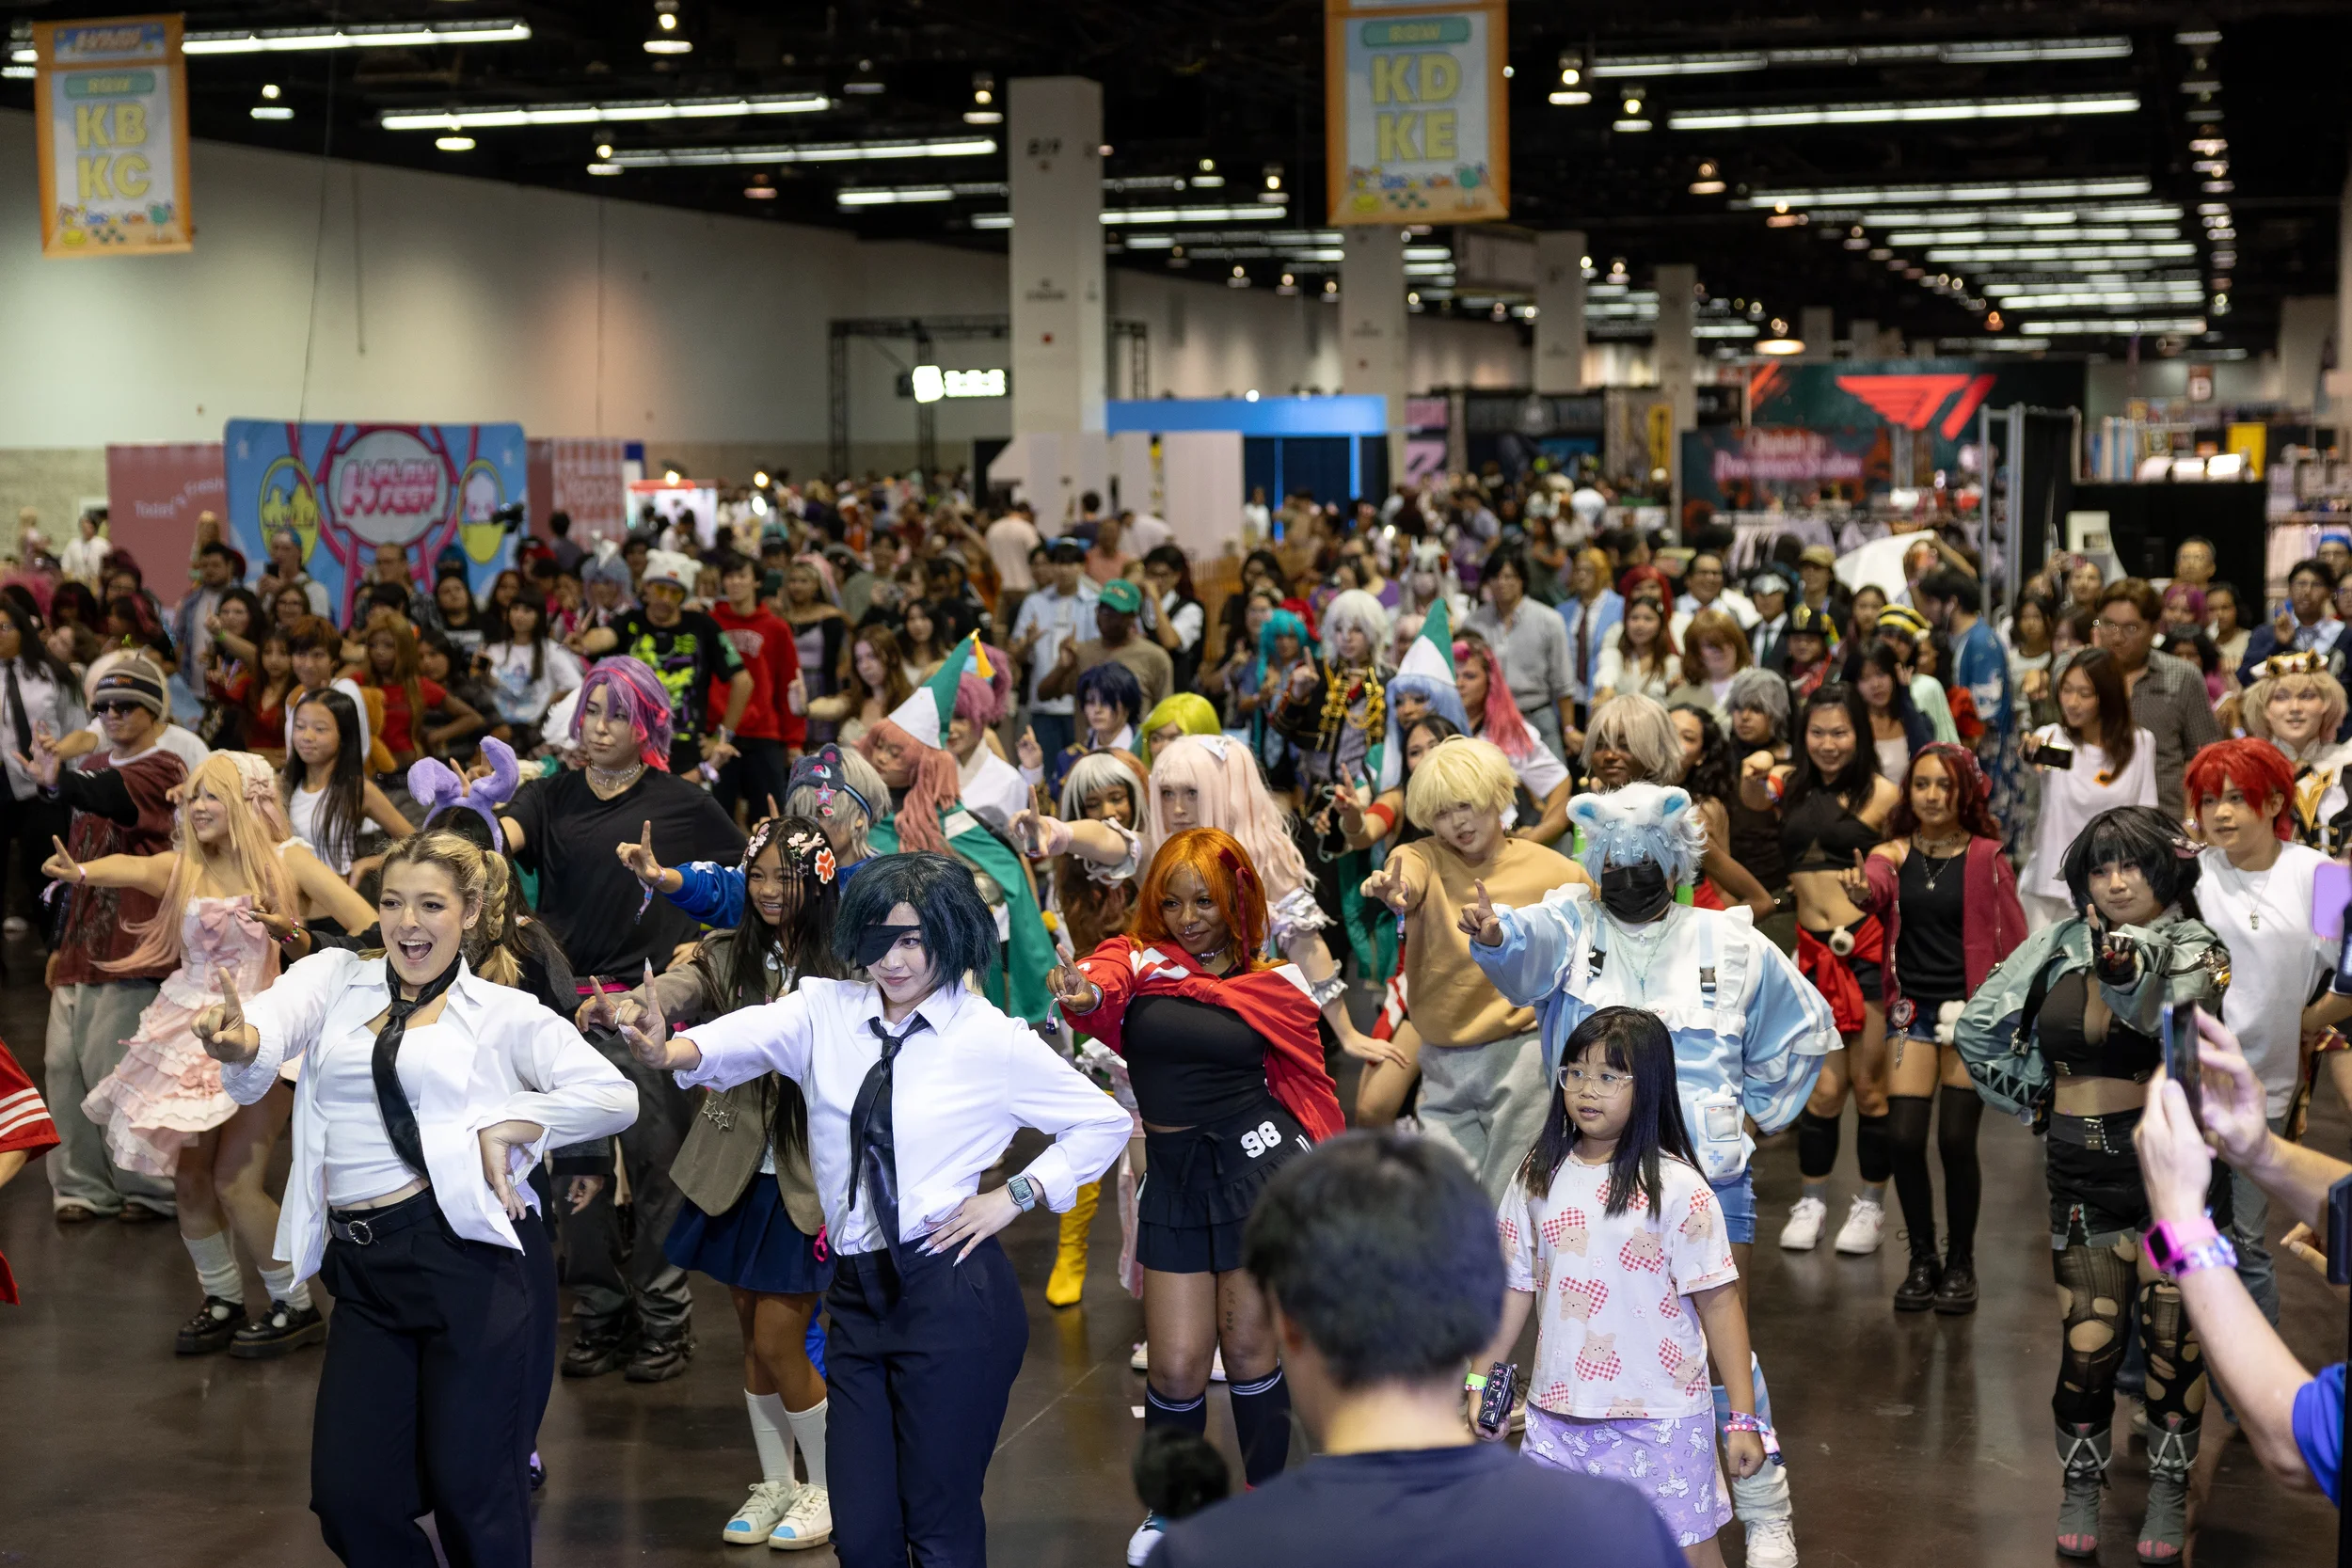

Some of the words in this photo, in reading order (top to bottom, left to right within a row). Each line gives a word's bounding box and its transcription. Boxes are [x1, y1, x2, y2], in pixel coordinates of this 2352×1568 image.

[1373, 52, 1462, 103] KD
[75, 103, 147, 149] KB
[1377, 110, 1456, 162] KE
[77, 152, 151, 199] KC
[1241, 1120, 1281, 1158] 98
